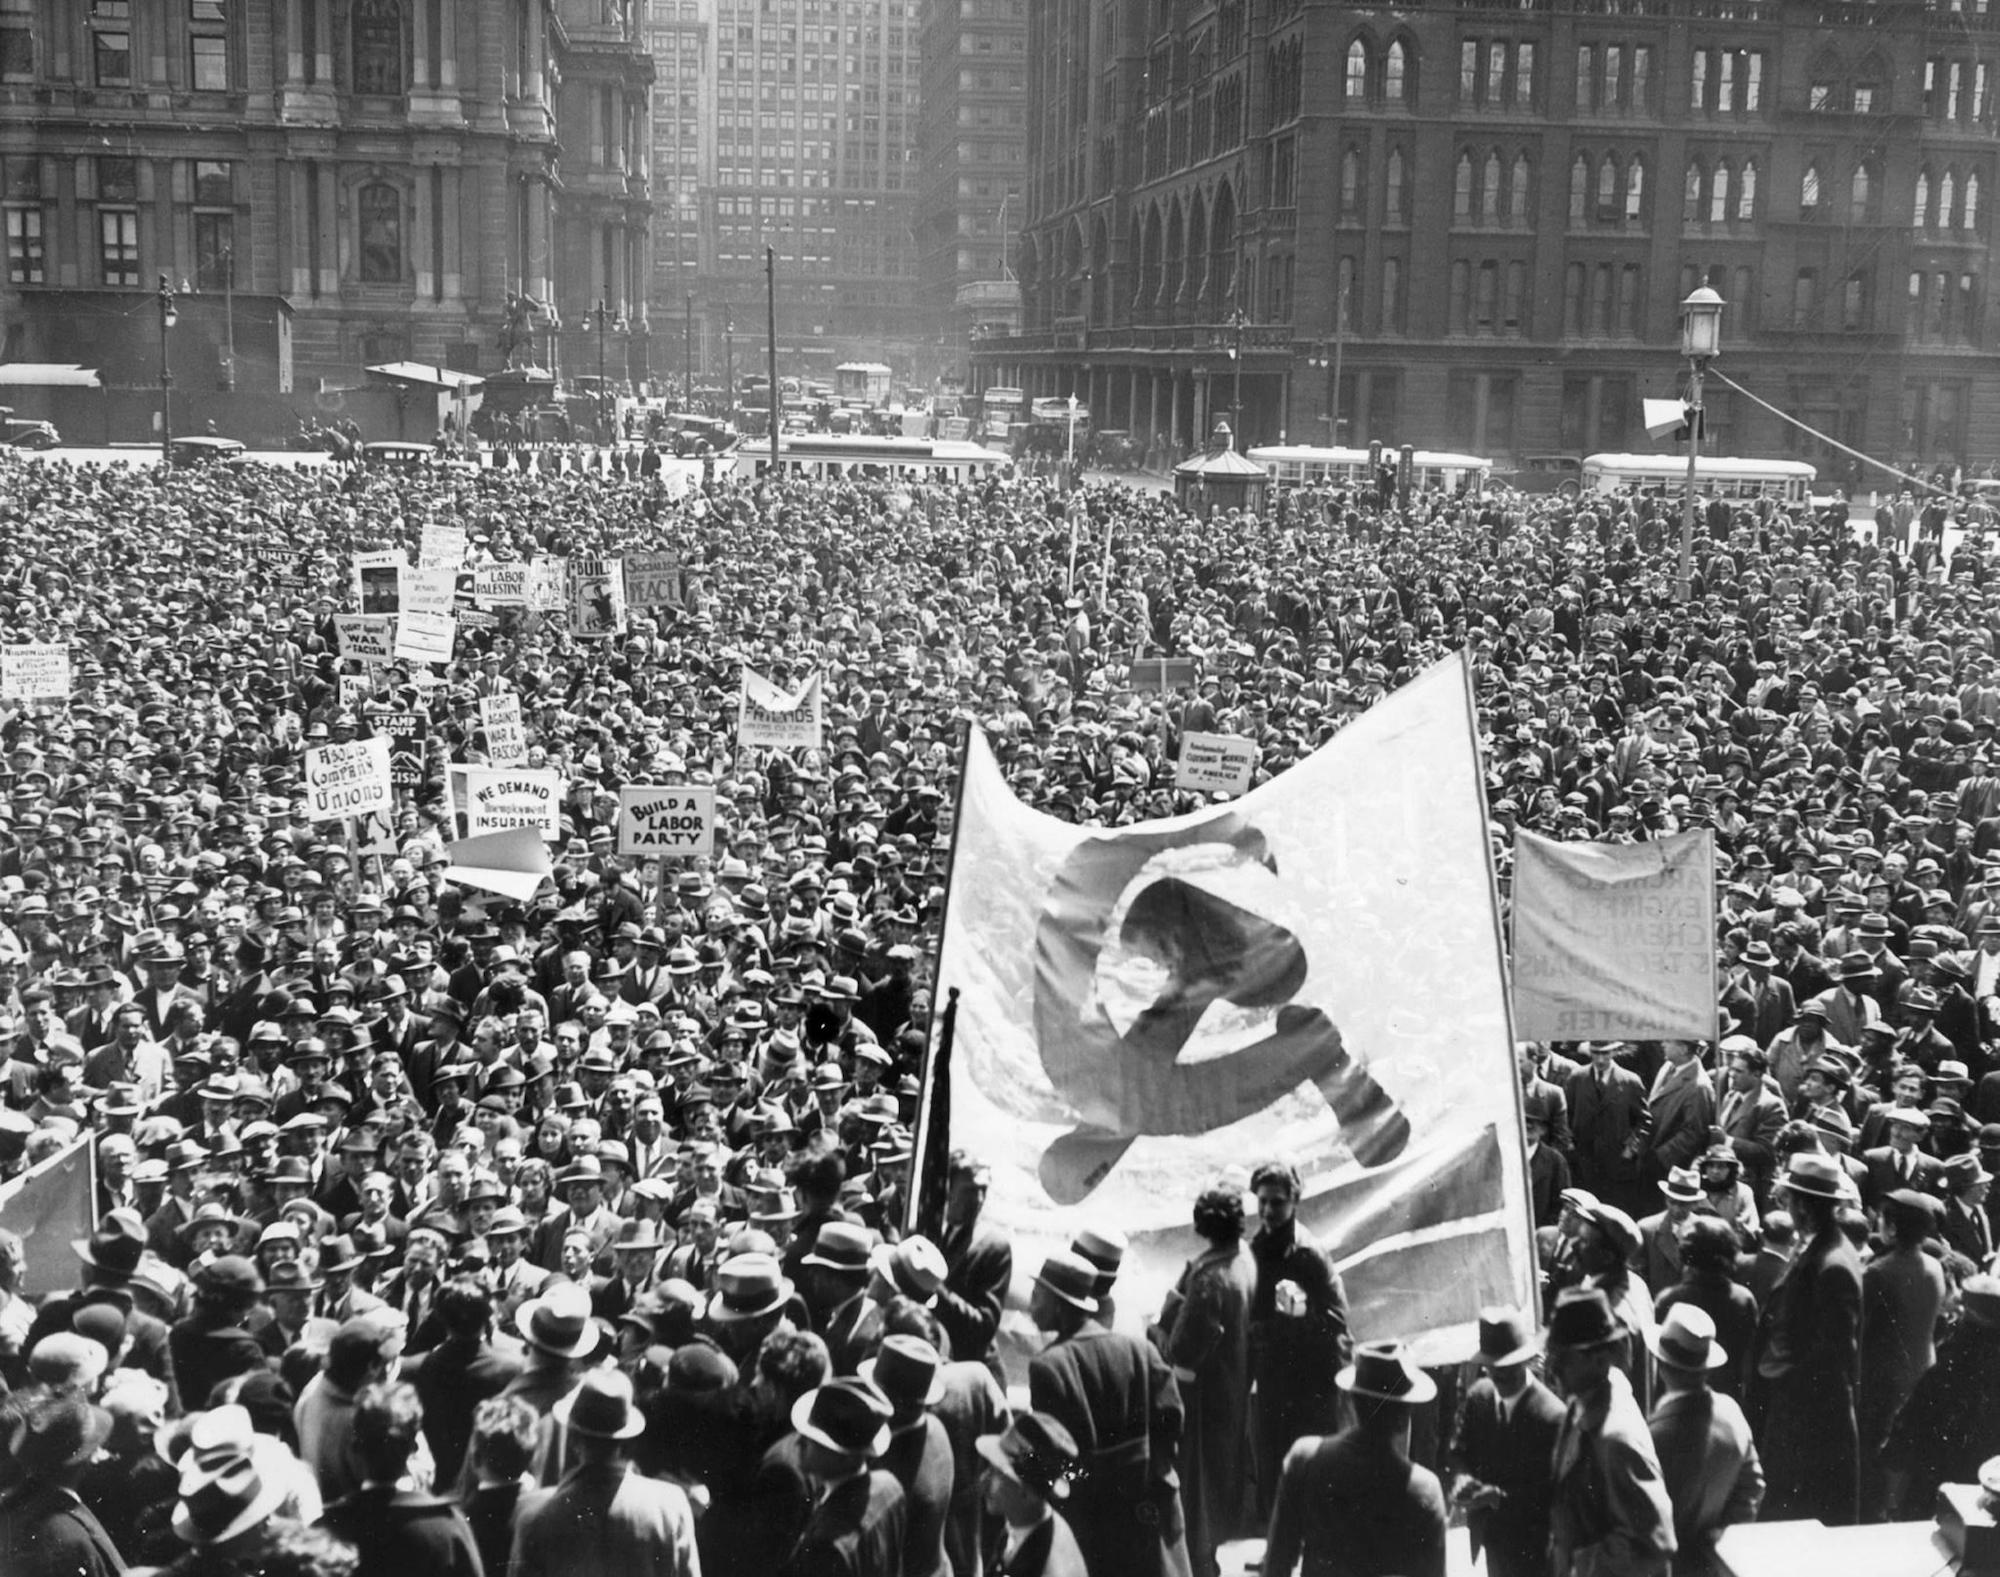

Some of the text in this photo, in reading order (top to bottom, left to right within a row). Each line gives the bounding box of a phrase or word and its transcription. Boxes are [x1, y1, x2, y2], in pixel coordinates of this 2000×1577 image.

[577, 561, 613, 576] BUILD
[490, 571, 526, 583] LABOR
[476, 583, 522, 595] PALESTINE
[347, 635, 380, 645] WAR
[374, 715, 417, 727] STAMP
[387, 727, 416, 736] OUT
[391, 772, 421, 783] CISM
[1203, 769, 1237, 779] AMERICA
[475, 782, 549, 802] WE DEMAND
[630, 798, 696, 821] BUILD A
[476, 817, 551, 829] INSURANCE
[649, 816, 703, 830] LABOR
[633, 832, 701, 845] PARTY
